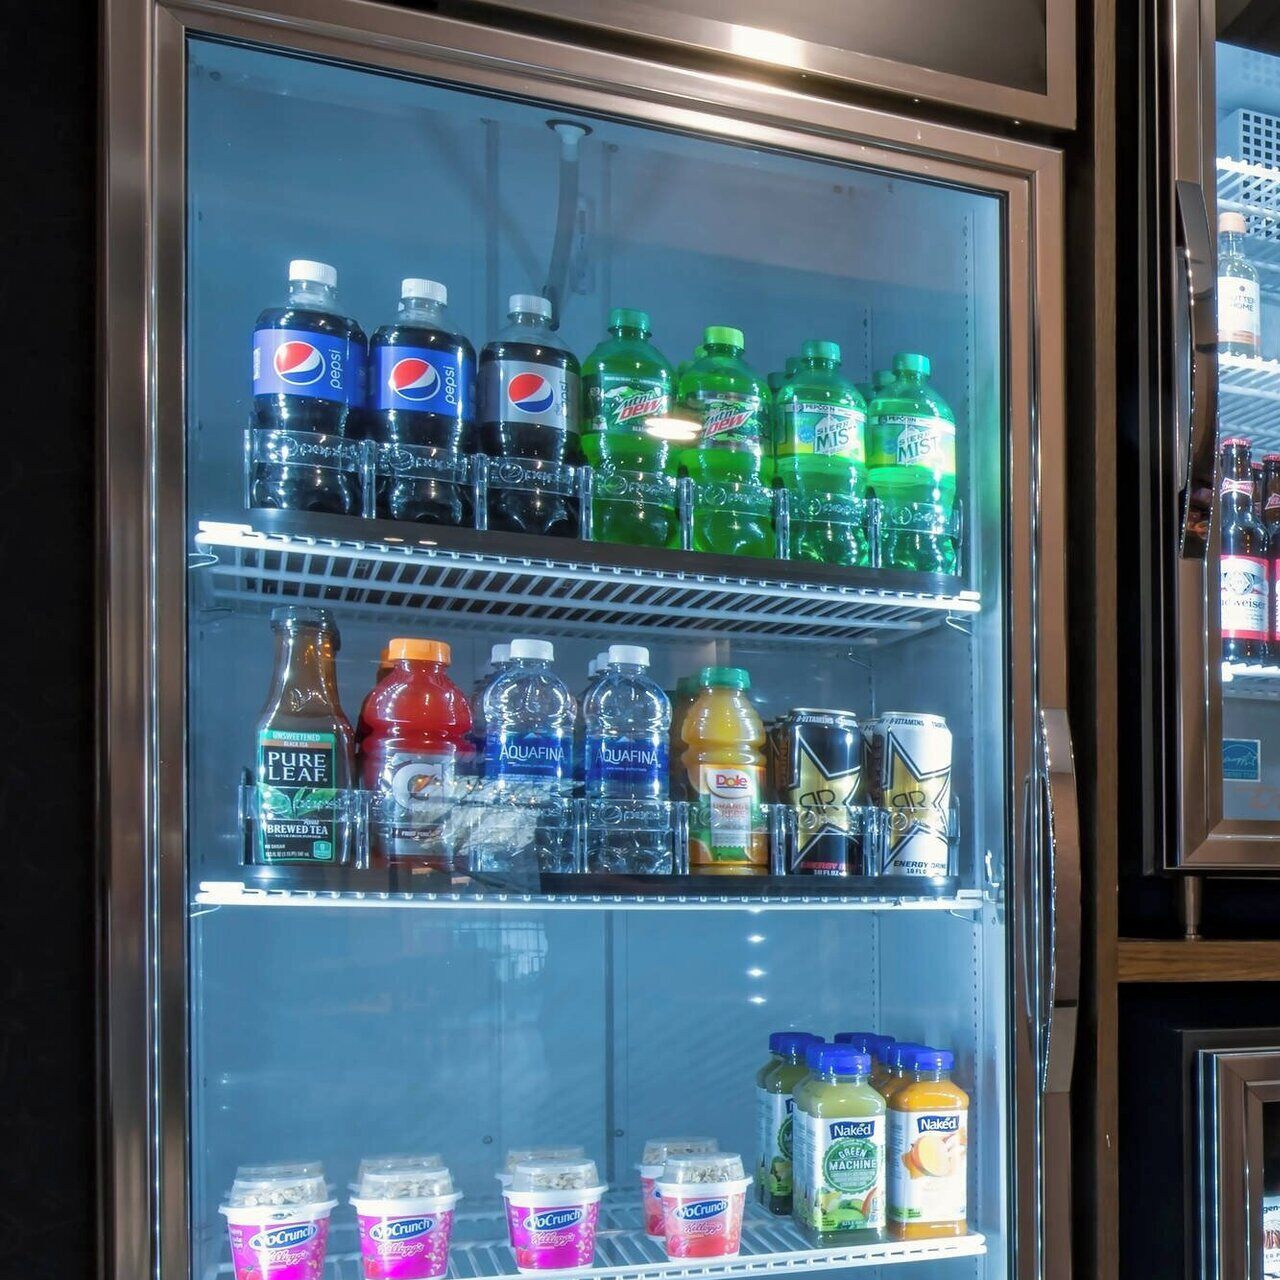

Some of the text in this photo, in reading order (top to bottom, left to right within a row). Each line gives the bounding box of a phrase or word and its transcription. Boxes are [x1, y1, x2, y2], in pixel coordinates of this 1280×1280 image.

[329, 349, 343, 390] pepsi
[445, 365, 456, 405] pepsi
[273, 732, 320, 742] UNSWEETENED
[268, 752, 326, 768] PURE
[499, 745, 565, 763] AQUAFINA
[269, 767, 325, 782] LEAF
[716, 773, 748, 788] Dole
[267, 823, 328, 836] BREWED TEA
[892, 860, 928, 869] ENERGY
[833, 1122, 872, 1138] Naked
[839, 1147, 867, 1159] GREEN
[829, 1160, 878, 1171] MACHINE
[677, 1201, 729, 1220] YoCrunch
[530, 1209, 582, 1229] YoCrunch
[373, 1218, 432, 1238] YoCrunch
[256, 1225, 316, 1248] YoCrunch
